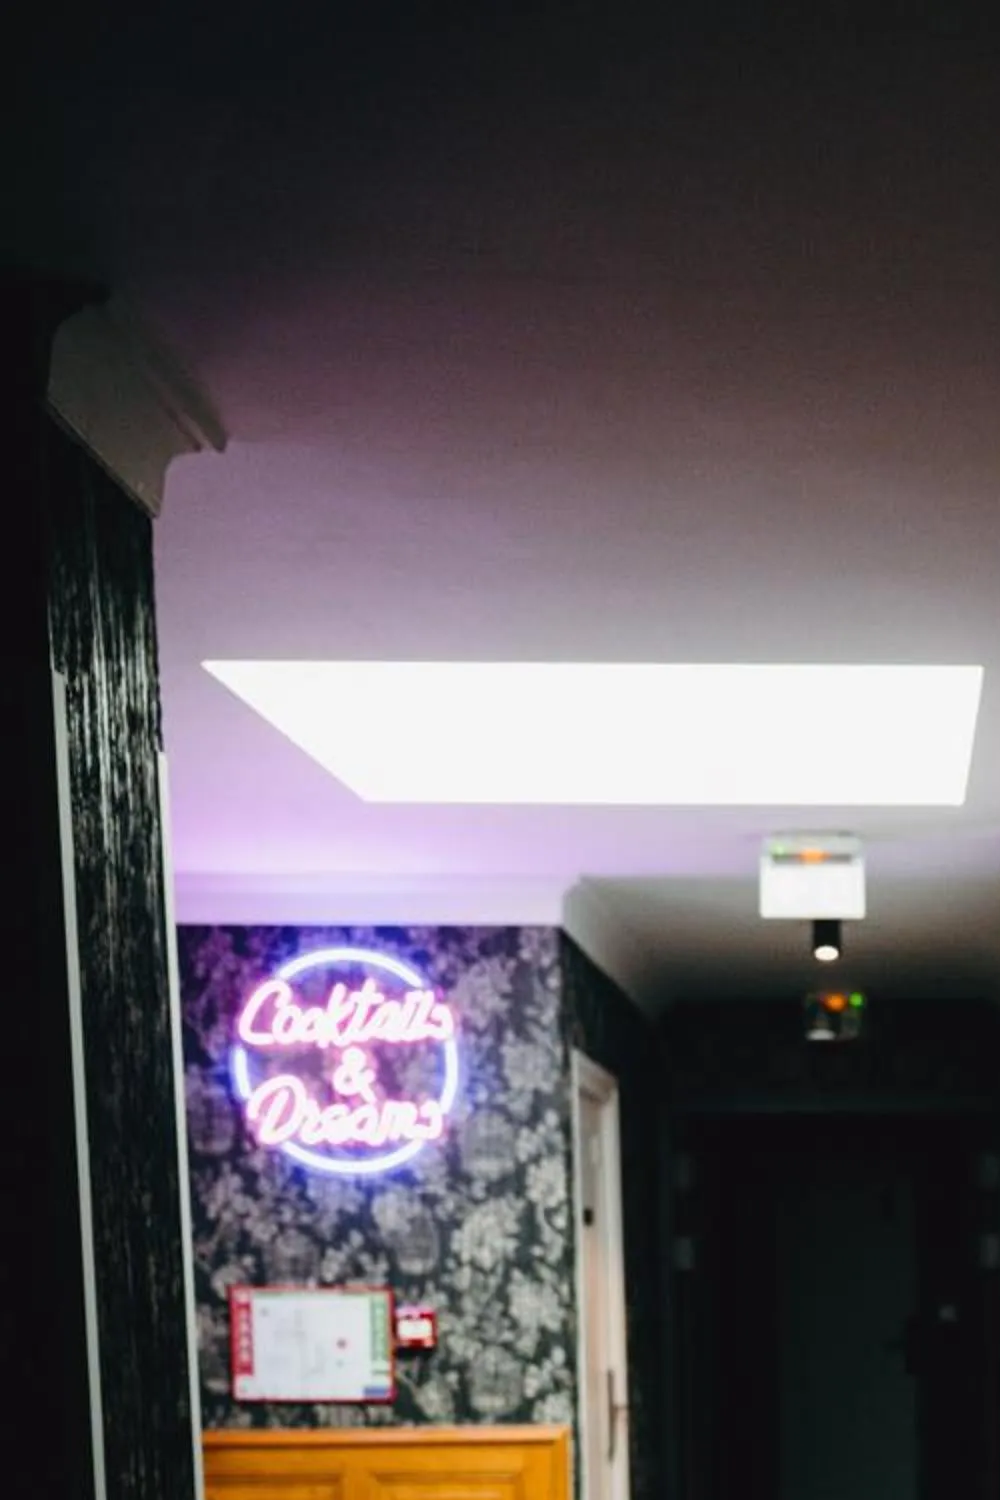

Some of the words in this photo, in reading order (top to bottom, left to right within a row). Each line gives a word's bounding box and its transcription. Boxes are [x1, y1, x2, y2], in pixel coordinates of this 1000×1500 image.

[239, 978, 454, 1048] Cocktails
[247, 1074, 443, 1145] Dreams
[333, 1047, 376, 1106] &
